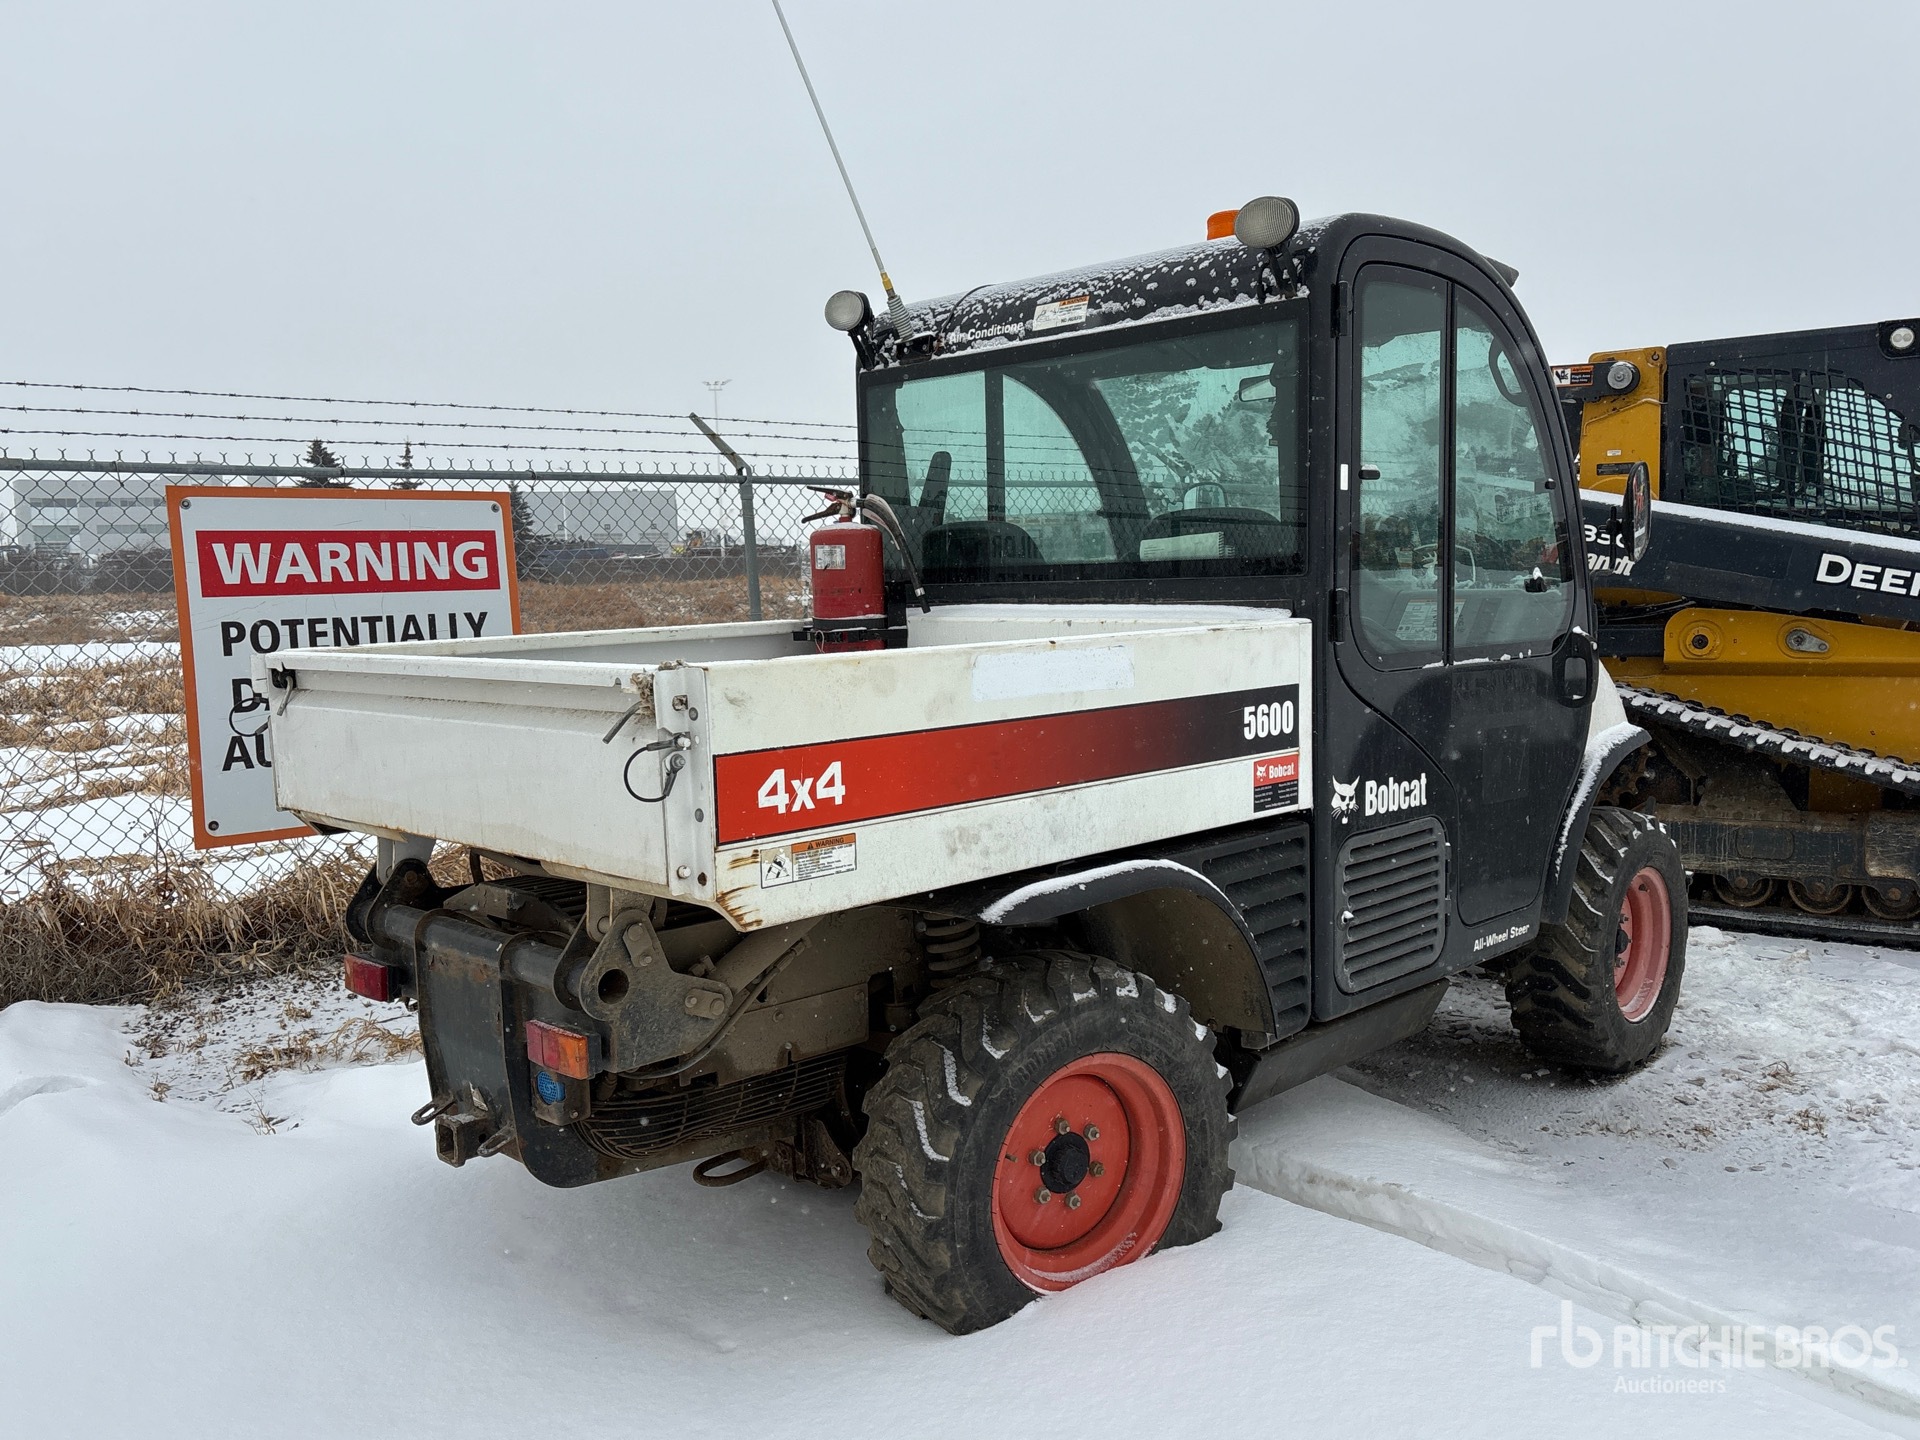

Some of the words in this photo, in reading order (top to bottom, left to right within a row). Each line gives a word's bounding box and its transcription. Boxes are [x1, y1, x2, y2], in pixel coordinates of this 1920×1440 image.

[211, 540, 489, 586] WARNING
[1243, 700, 1295, 741] 5600
[757, 760, 846, 815] 4x4
[1268, 762, 1295, 780] Bobcat
[1364, 772, 1428, 817] Bobcat
[815, 837, 845, 849] WARNING
[1473, 929, 1509, 952] All-Wheel
[1510, 924, 1530, 939] Steer
